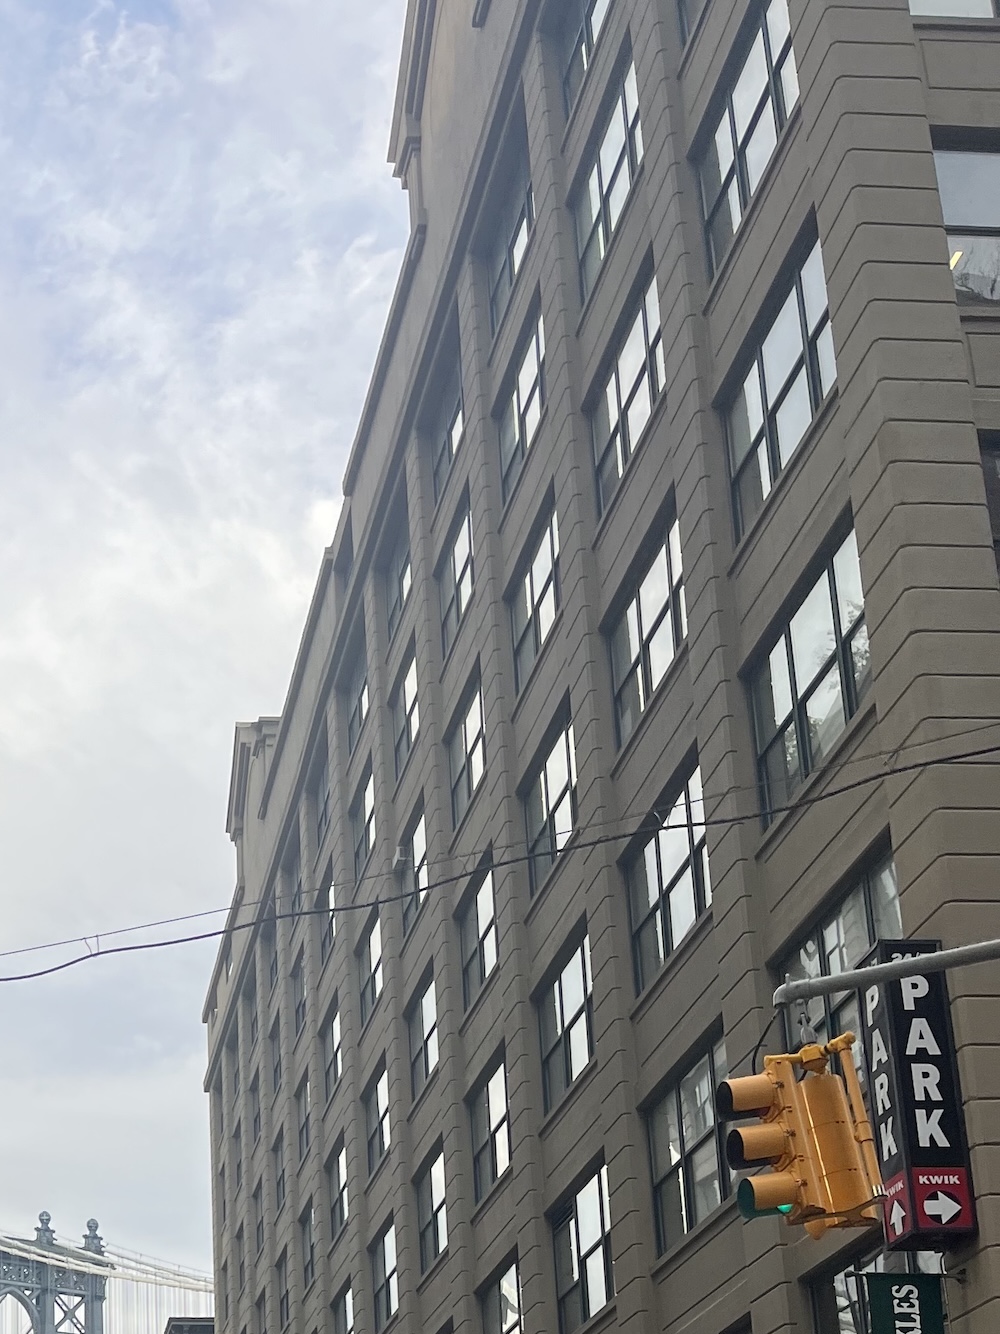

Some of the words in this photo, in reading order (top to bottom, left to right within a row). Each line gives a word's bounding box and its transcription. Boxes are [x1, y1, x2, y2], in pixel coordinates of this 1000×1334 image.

[865, 984, 898, 1162] PARK
[900, 974, 951, 1147] PARK
[918, 1174, 961, 1185] KWIK
